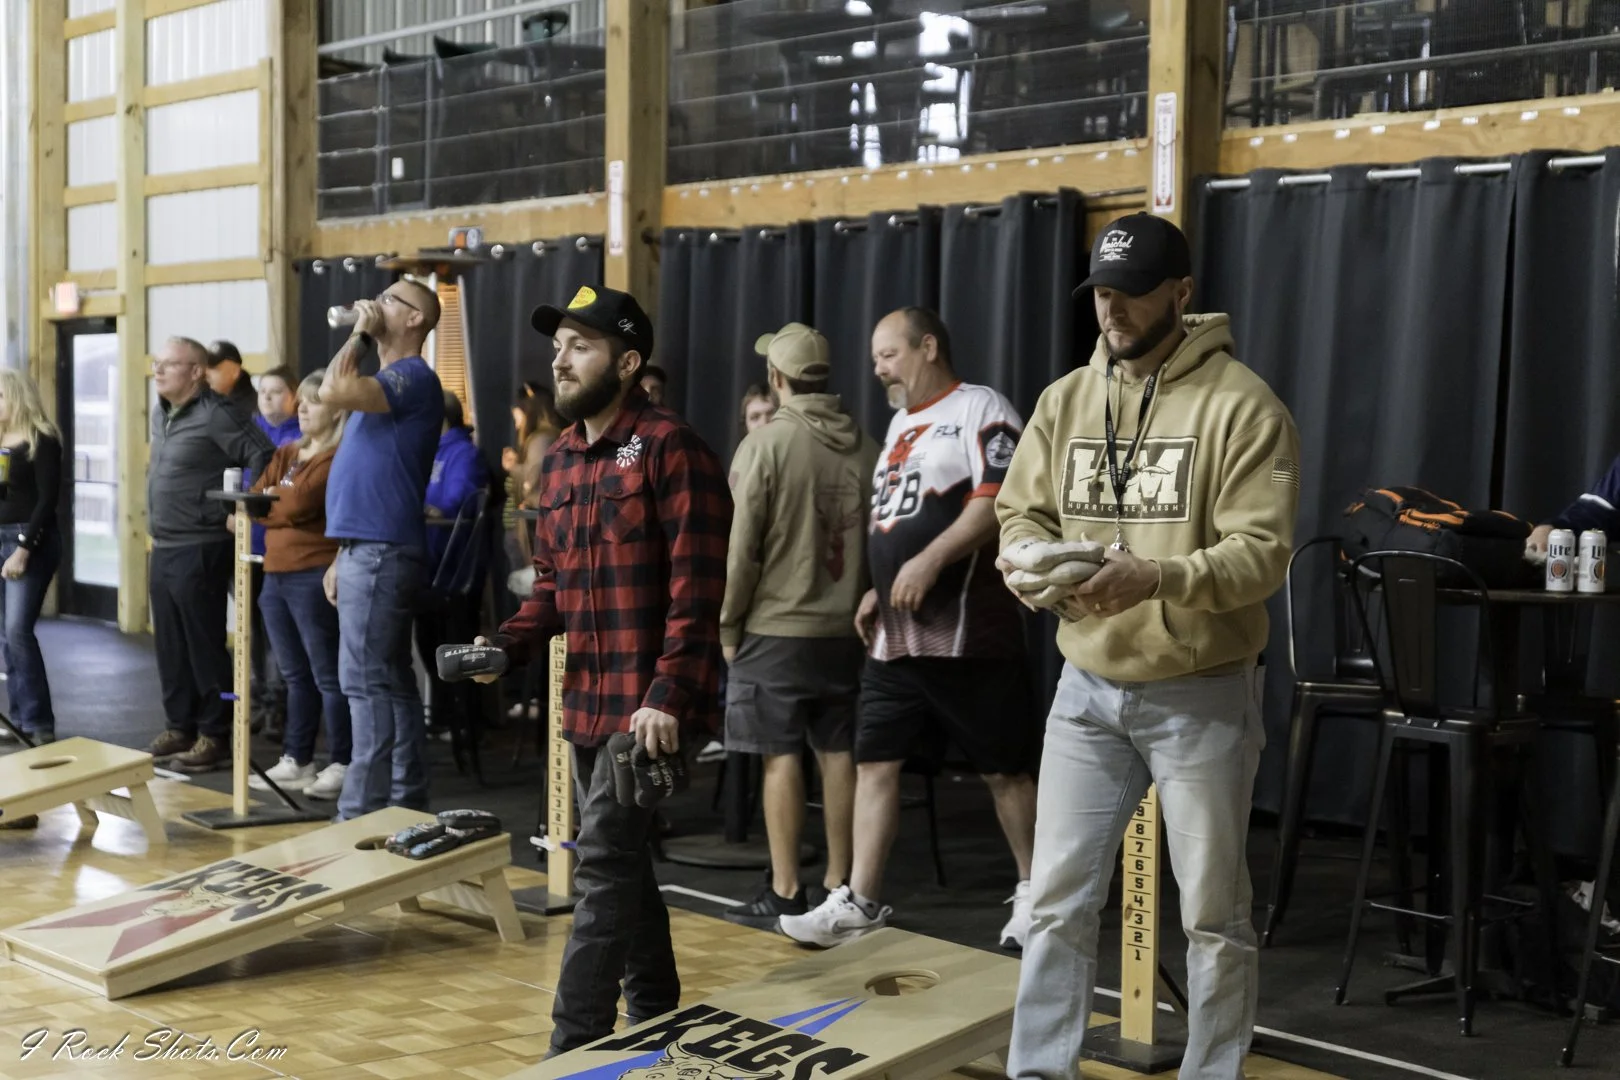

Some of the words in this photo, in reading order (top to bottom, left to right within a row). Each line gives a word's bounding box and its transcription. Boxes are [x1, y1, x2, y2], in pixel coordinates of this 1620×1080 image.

[1069, 448, 1185, 504] HM
[1068, 502, 1136, 512] HURRICNE
[1142, 504, 1178, 512] MARSH
[1550, 544, 1571, 559] Lite
[554, 646, 564, 655] 14
[1136, 805, 1145, 817] 9
[1136, 824, 1145, 835] 8
[1135, 841, 1144, 853] 7
[1135, 860, 1144, 871] 6
[1135, 877, 1144, 889] 5
[137, 860, 333, 921] KEGS
[1134, 895, 1144, 907] 4
[1134, 913, 1143, 925] 3
[1134, 931, 1143, 943] 2
[1135, 949, 1141, 961] 1
[584, 1003, 870, 1080] KEGS
